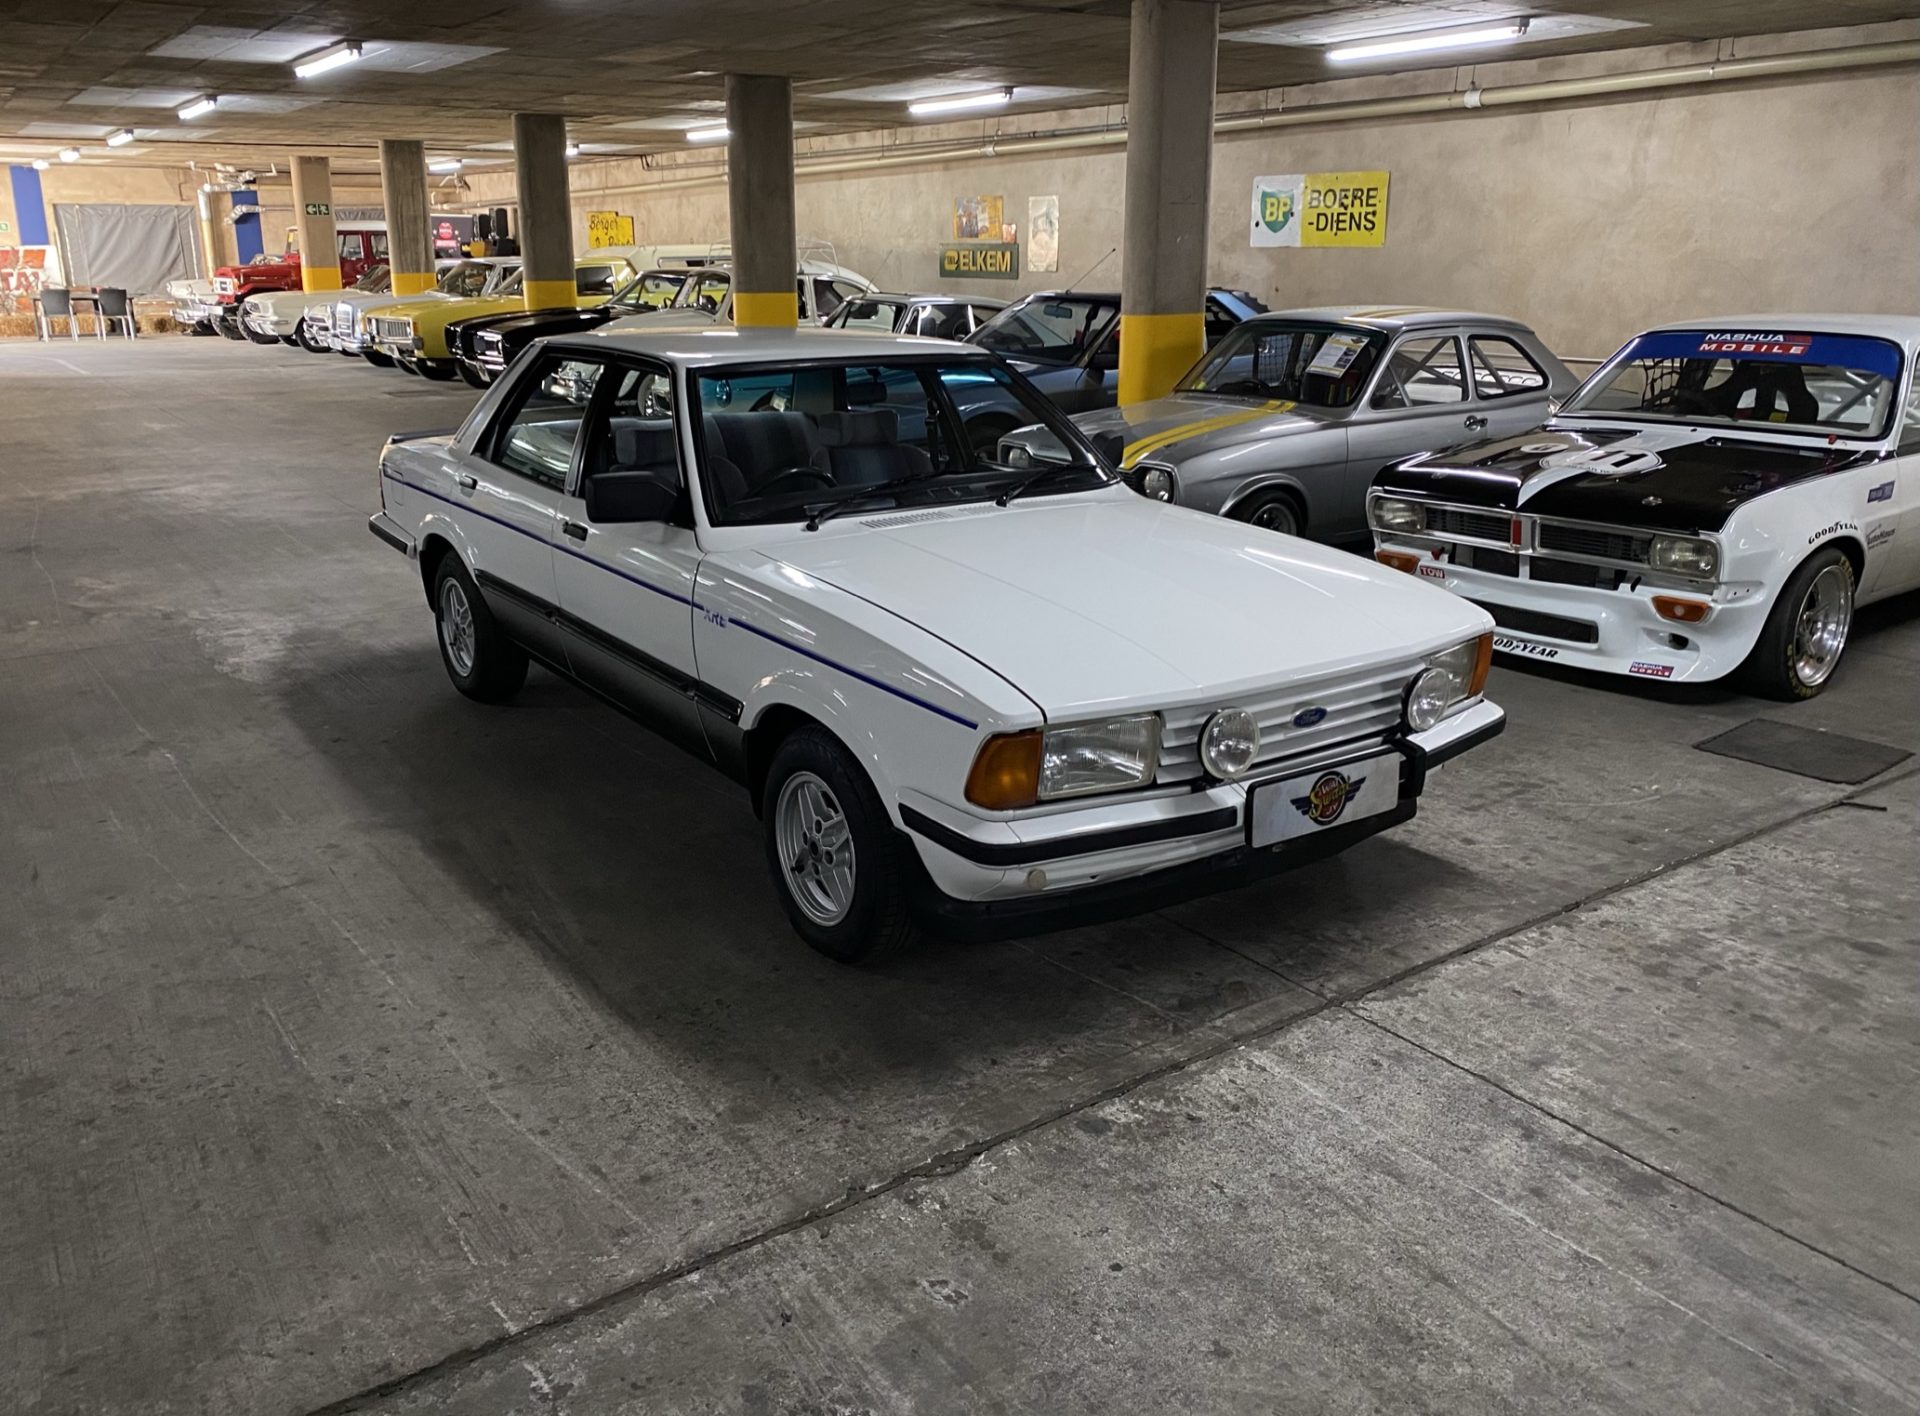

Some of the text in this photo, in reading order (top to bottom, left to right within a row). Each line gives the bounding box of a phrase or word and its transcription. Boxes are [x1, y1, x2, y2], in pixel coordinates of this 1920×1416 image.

[1309, 187, 1379, 208] BOERE
[1265, 197, 1291, 222] BP
[1705, 333, 1785, 342] NASHUA
[1699, 343, 1805, 354] MOBILE
[1808, 520, 1859, 545] GOODYEAR
[1421, 566, 1444, 578] TOW
[1493, 637, 1559, 658] ODYEAR
